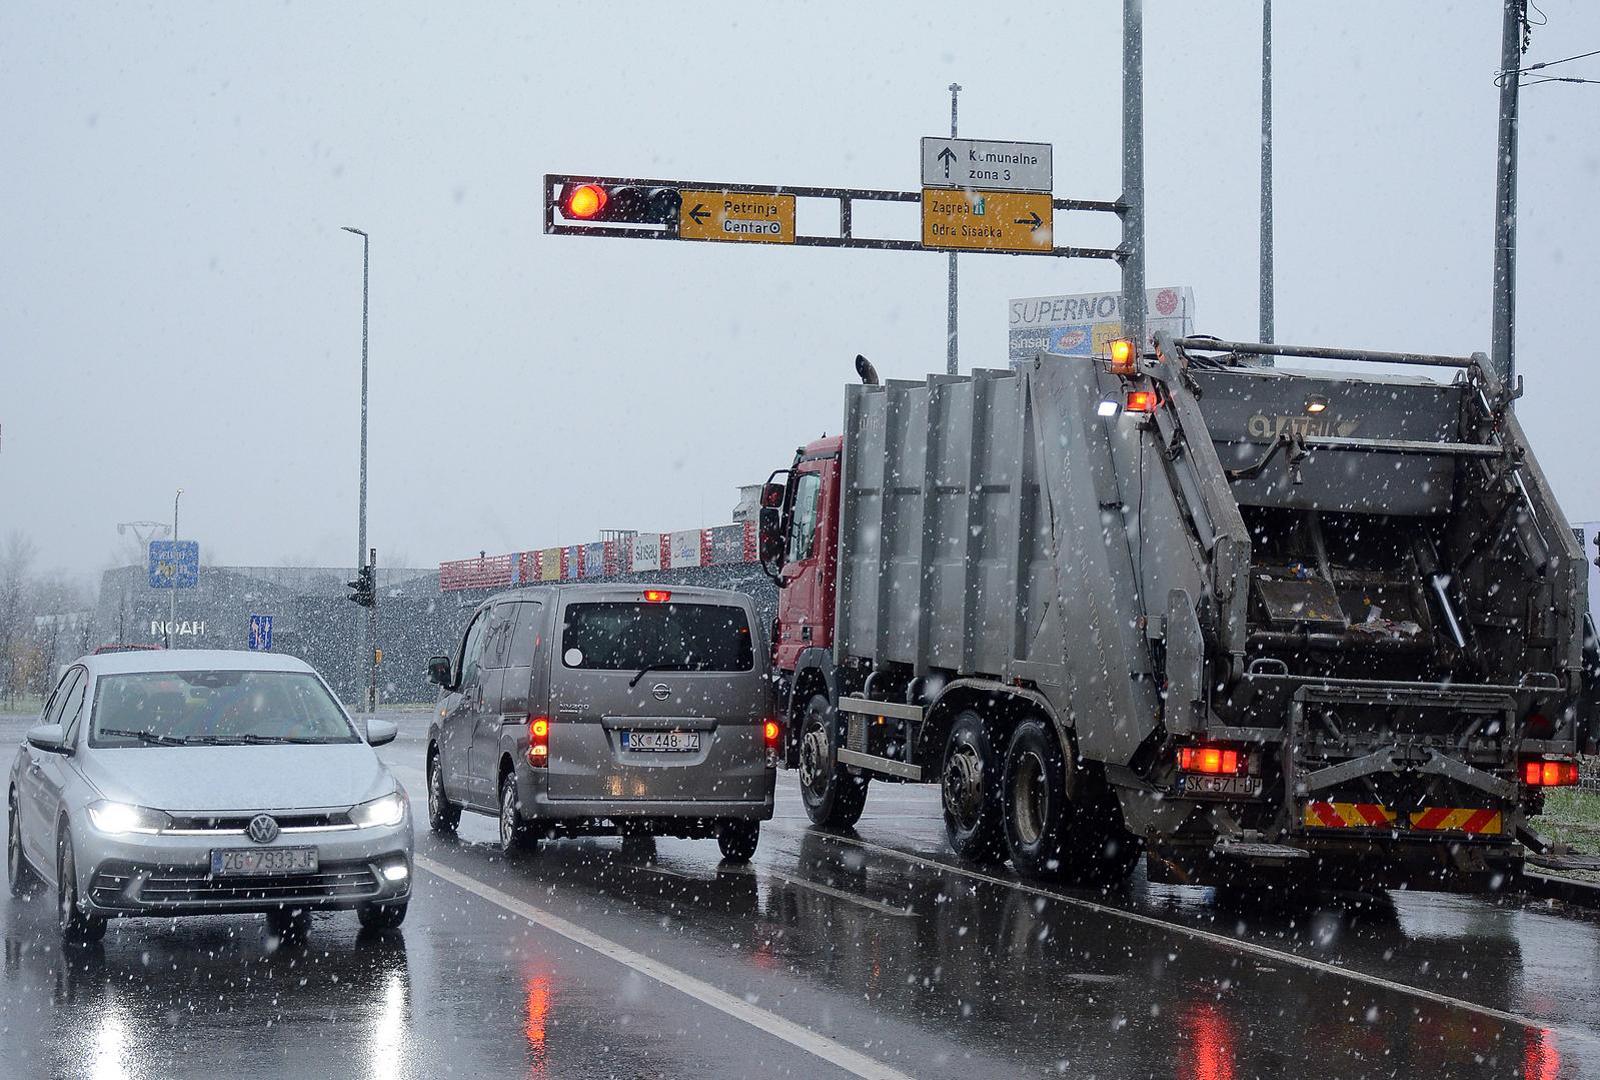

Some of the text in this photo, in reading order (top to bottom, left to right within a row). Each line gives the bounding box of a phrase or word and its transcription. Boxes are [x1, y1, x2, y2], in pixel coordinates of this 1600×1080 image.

[969, 169, 1011, 181] zona 3
[724, 200, 777, 217] Petrinja
[724, 219, 768, 234] Centar
[932, 223, 957, 237] Odra
[151, 620, 205, 635] NOAH
[630, 734, 645, 748] SK
[1187, 775, 1203, 791] SK
[224, 852, 244, 870] ZG
